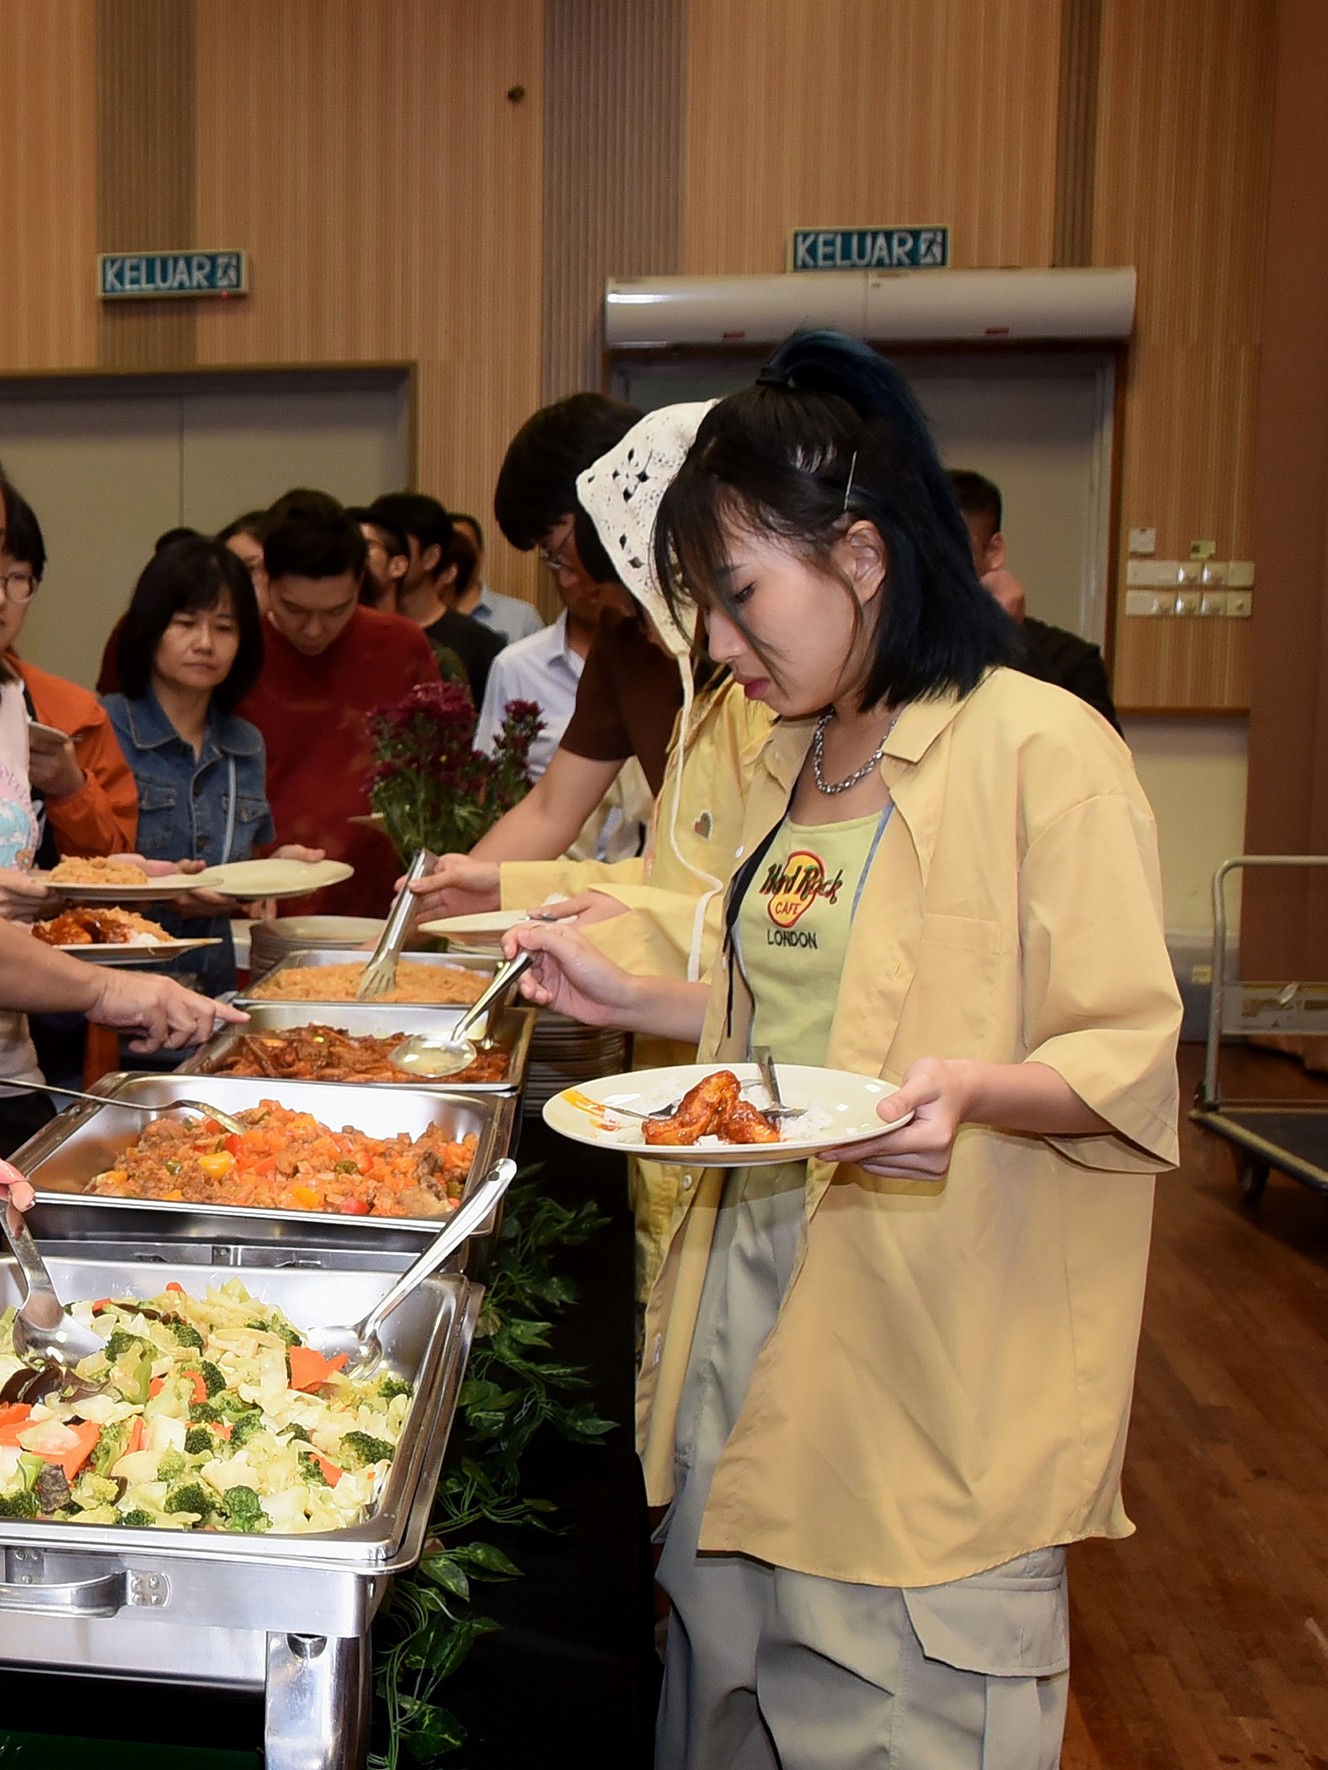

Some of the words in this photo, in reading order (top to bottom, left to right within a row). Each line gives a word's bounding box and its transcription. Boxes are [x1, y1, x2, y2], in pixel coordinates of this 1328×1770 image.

[796, 232, 913, 267] KELUAR
[105, 256, 211, 290] KELUAR
[759, 863, 802, 895] Hard
[793, 865, 843, 904] Rock
[775, 901, 801, 914] CAFE
[767, 929, 818, 949] LONDON
